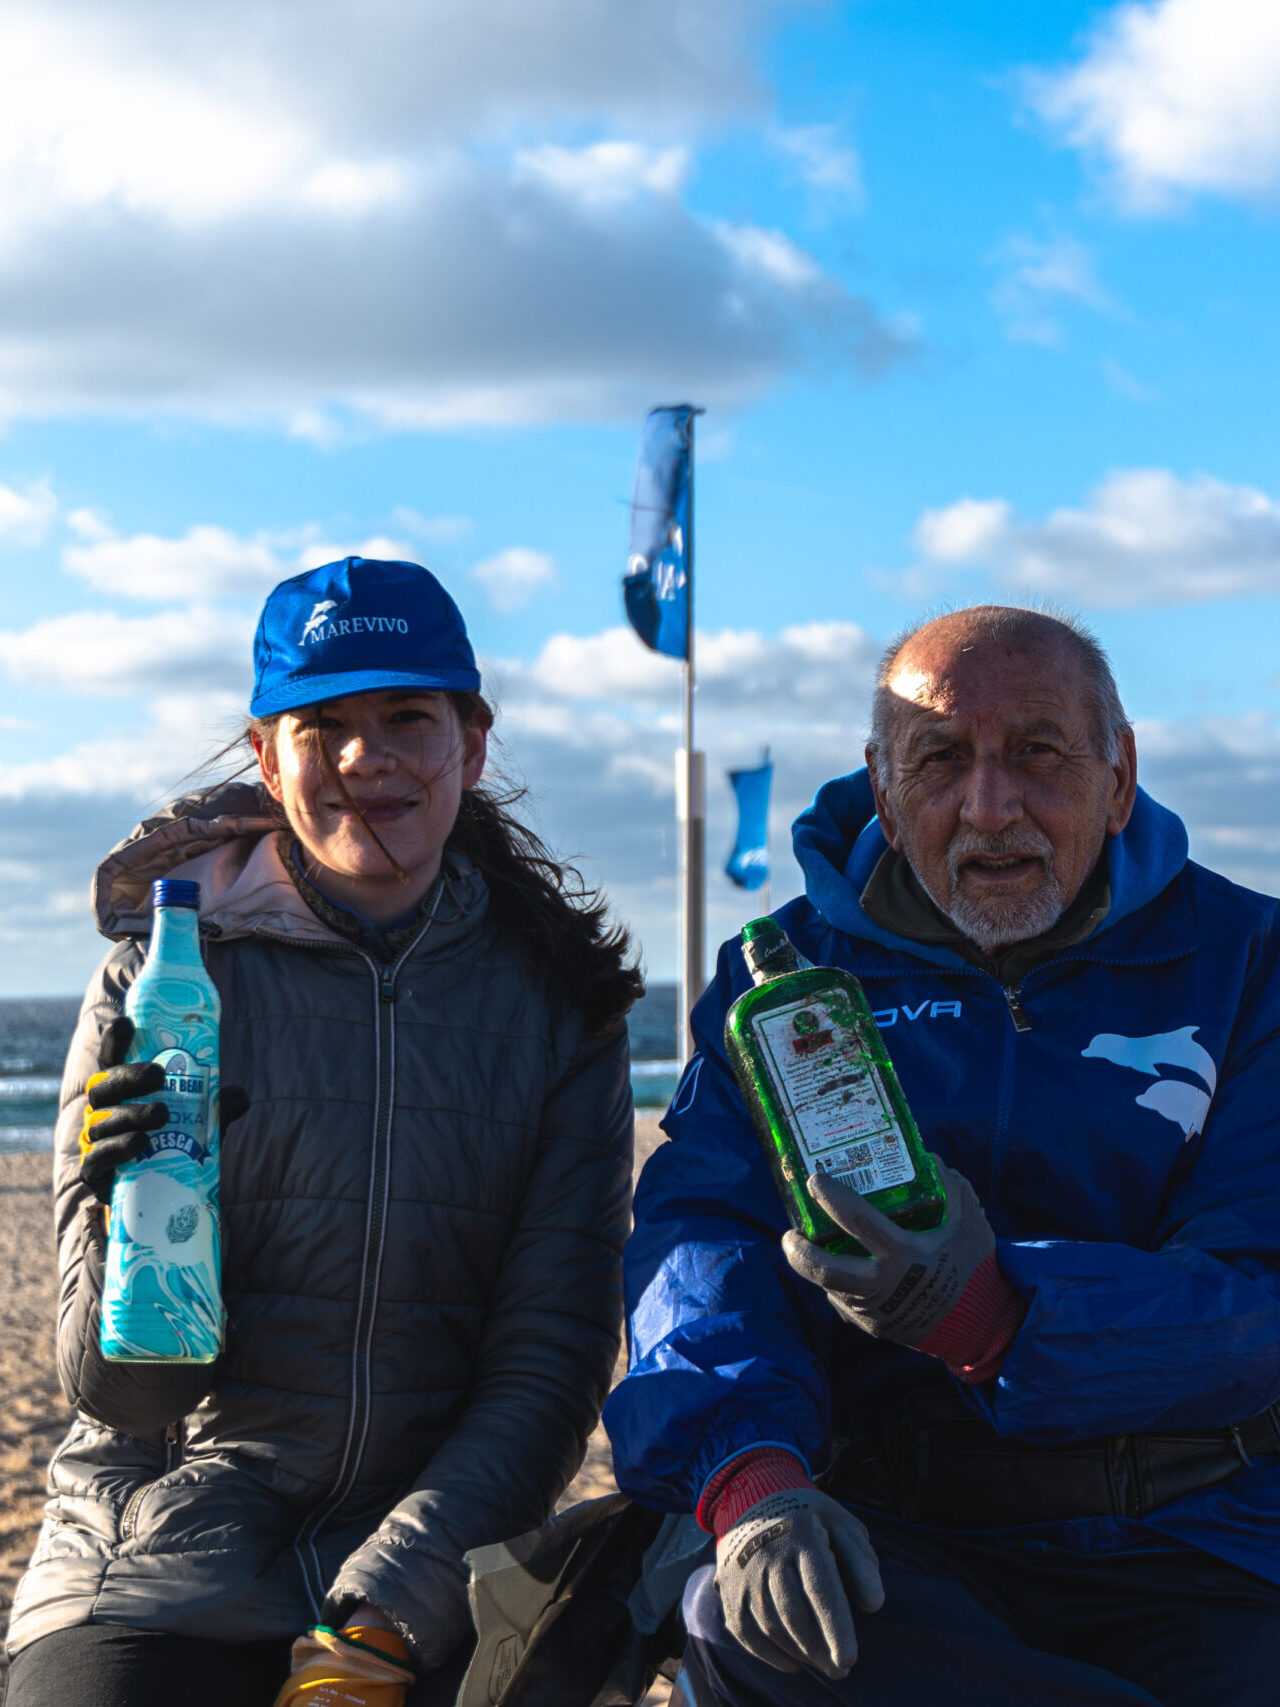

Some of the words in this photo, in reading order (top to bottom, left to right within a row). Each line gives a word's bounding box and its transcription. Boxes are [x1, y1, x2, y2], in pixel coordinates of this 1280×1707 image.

[310, 616, 408, 644] MAREVIVO
[871, 1000, 961, 1029] OVA
[180, 1078, 204, 1093] BEAR
[167, 1111, 205, 1126] DKA
[150, 1132, 194, 1152] PESCA
[751, 1523, 785, 1551] CUT
